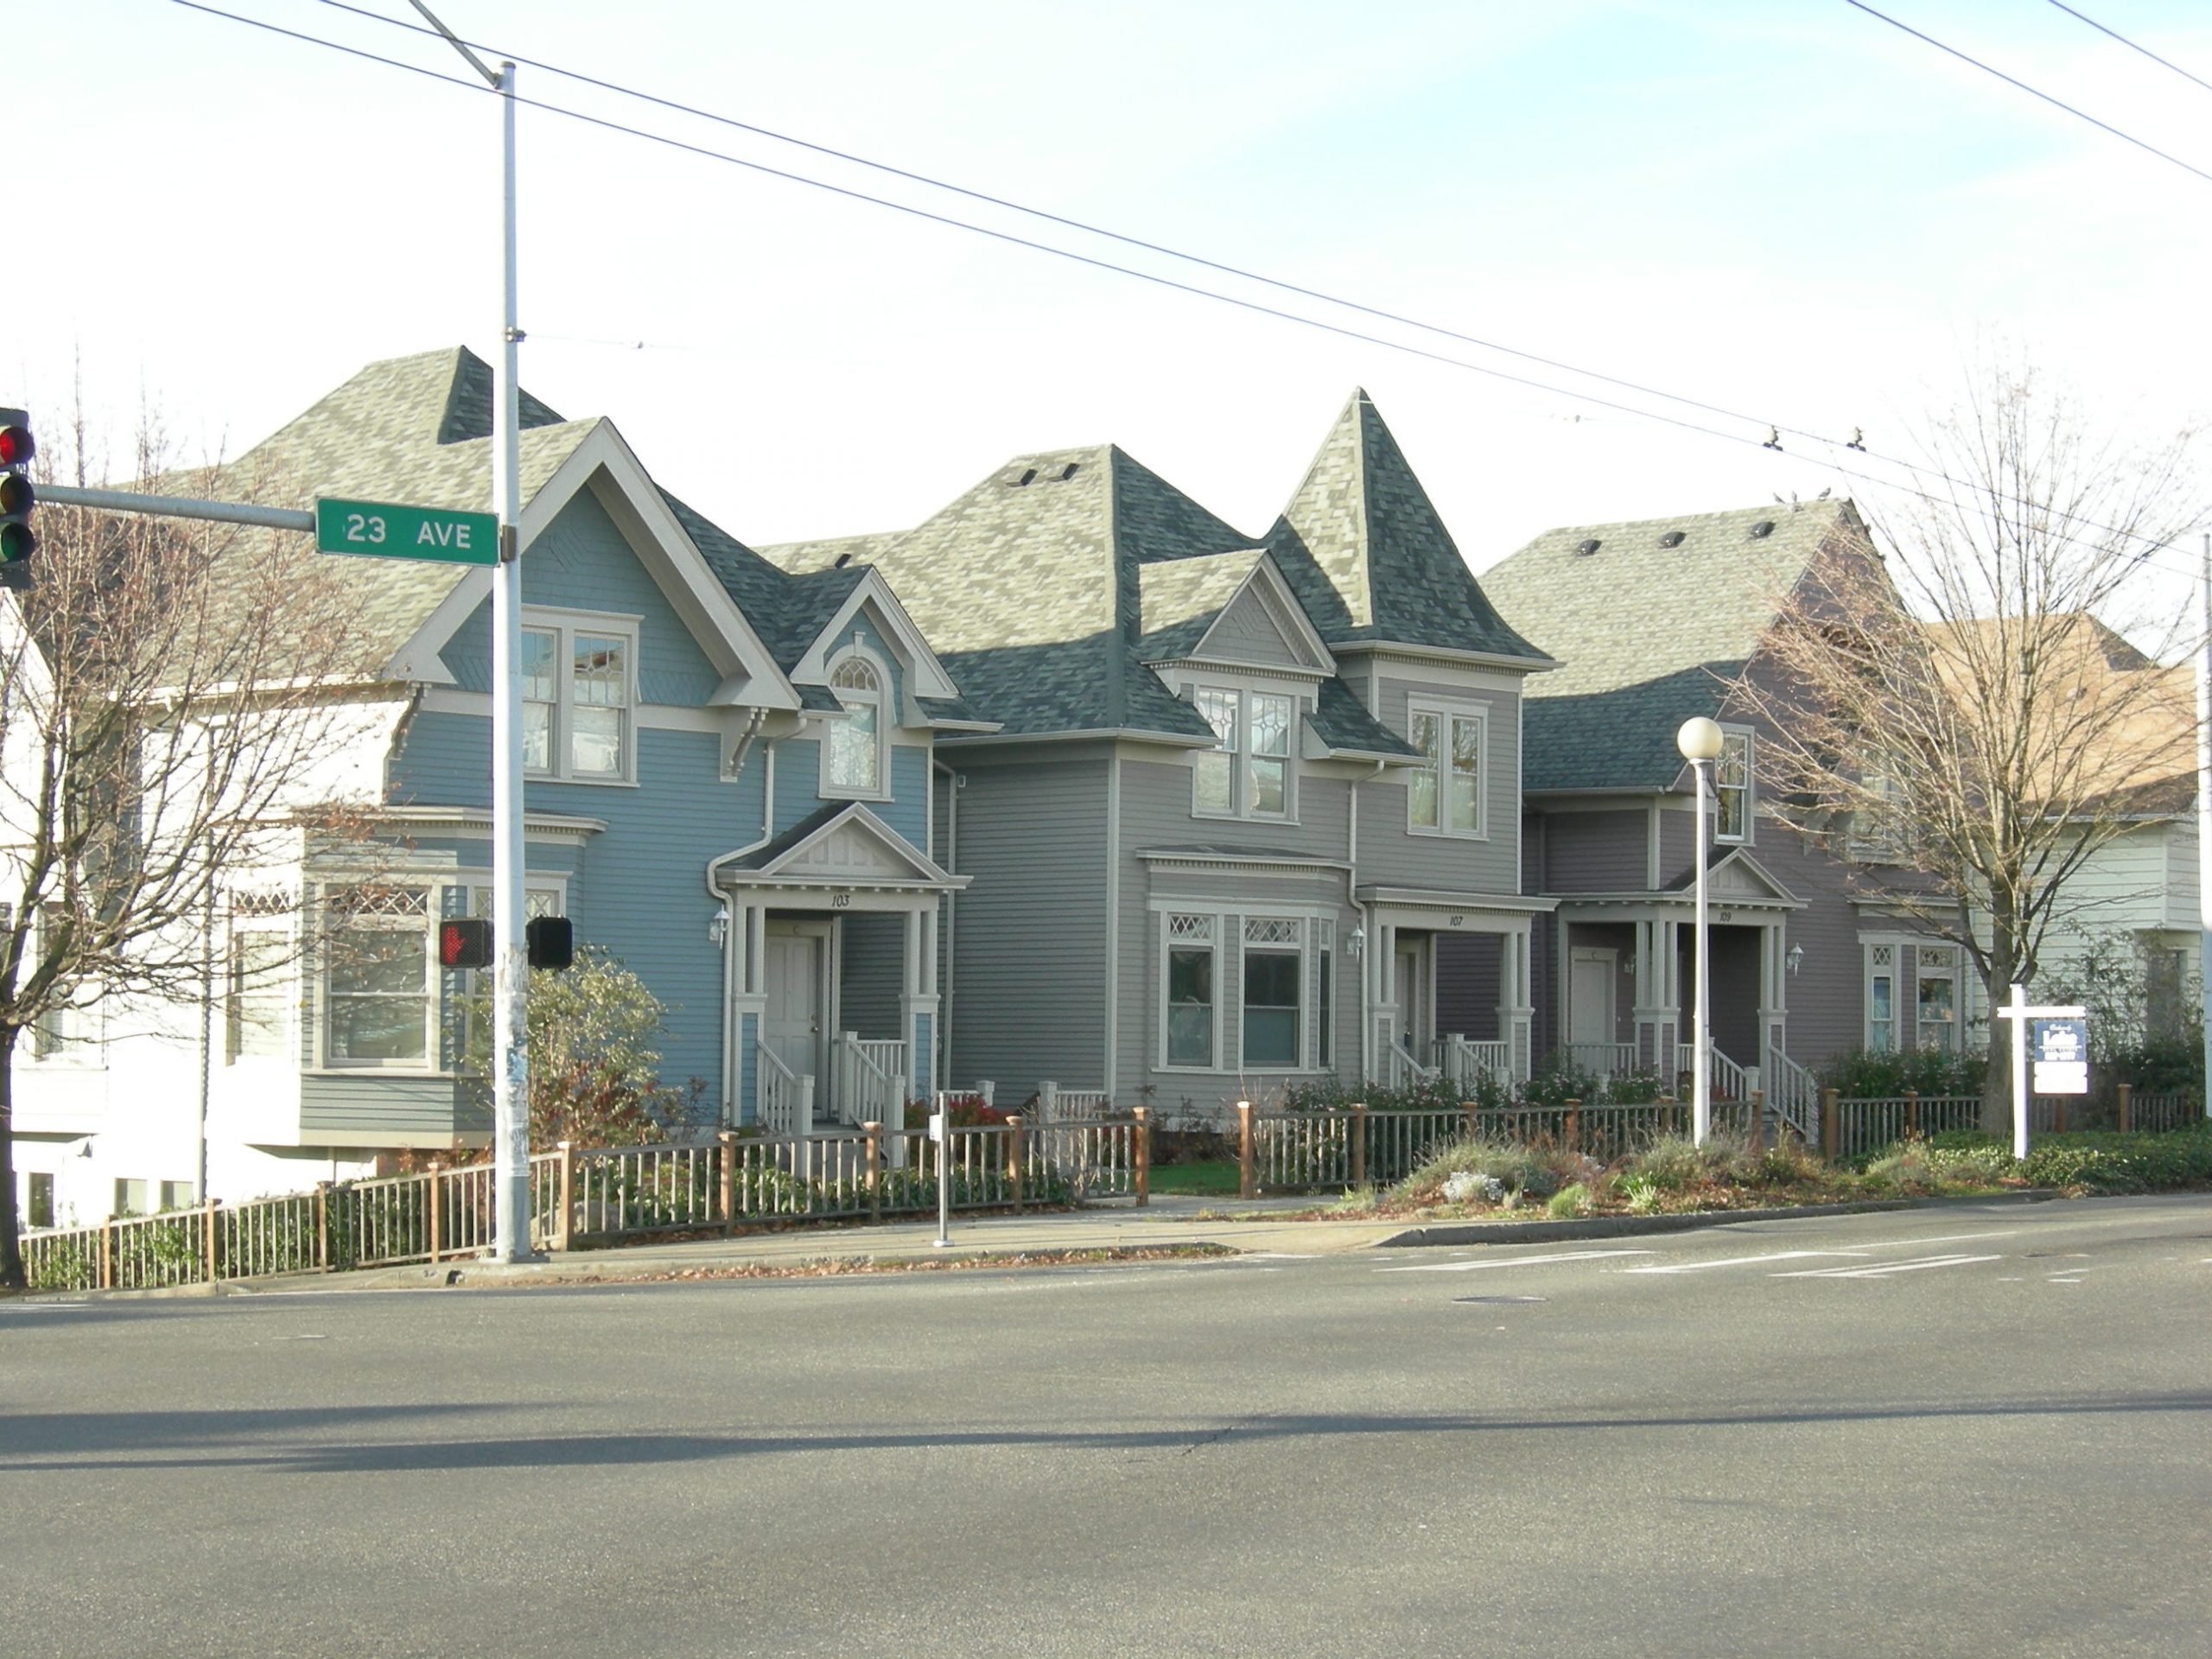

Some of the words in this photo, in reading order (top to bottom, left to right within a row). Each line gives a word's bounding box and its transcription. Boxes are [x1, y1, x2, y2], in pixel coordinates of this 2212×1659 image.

[346, 513, 386, 543] 23
[416, 520, 471, 549] AVE
[831, 894, 849, 907] 103
[1449, 915, 1464, 926] 107
